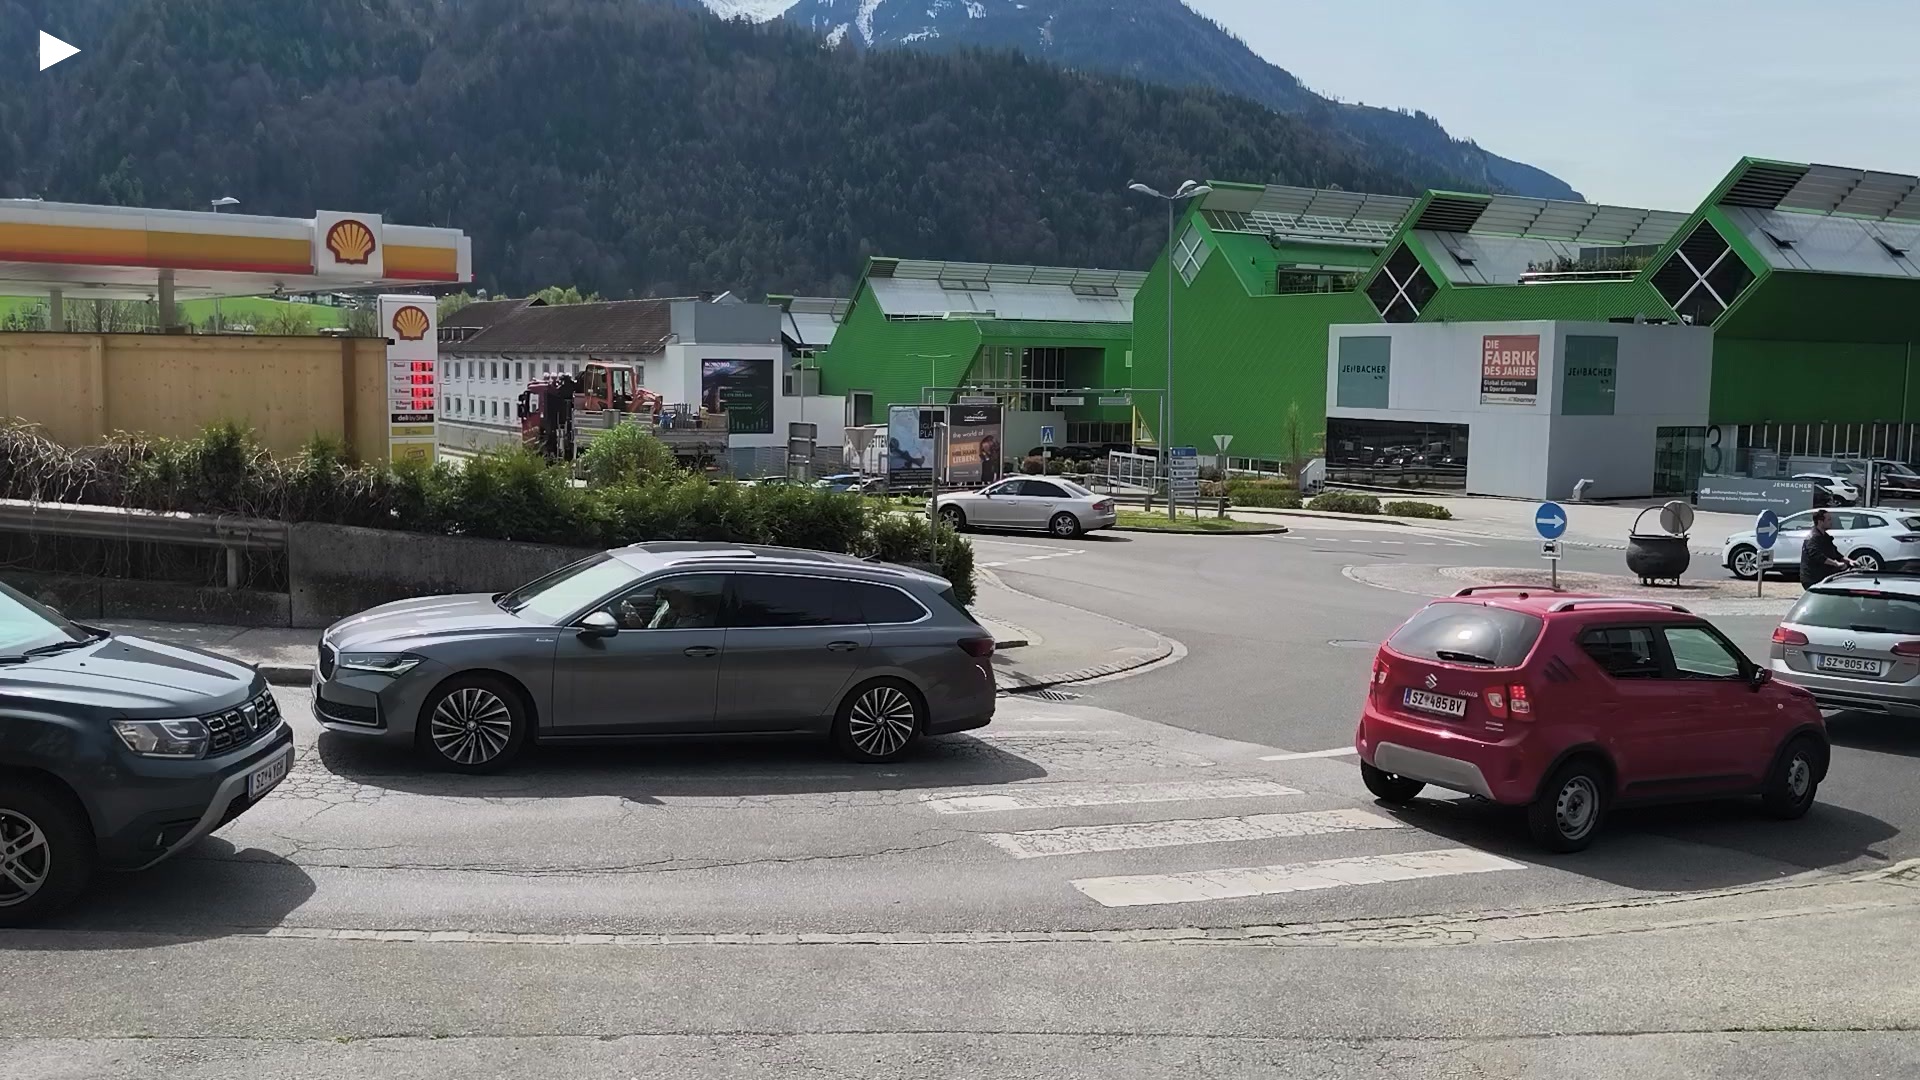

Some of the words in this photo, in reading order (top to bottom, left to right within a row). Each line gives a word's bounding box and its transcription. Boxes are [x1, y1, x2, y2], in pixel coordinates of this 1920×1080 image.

[1485, 340, 1500, 349] DIE
[1484, 350, 1537, 366] FABRIK
[1342, 365, 1387, 374] JENBACHER
[1484, 366, 1501, 376] DES
[1502, 366, 1536, 376] JAHRES
[1567, 368, 1613, 376] JENBACHER
[1500, 380, 1527, 388] Excellence
[1704, 425, 1722, 474] 3
[1825, 657, 1839, 667] SZ
[1844, 660, 1863, 670] 805
[1864, 661, 1877, 671] KS
[1412, 691, 1425, 705] SZ
[1430, 695, 1448, 710] 485
[1449, 699, 1463, 712] BV
